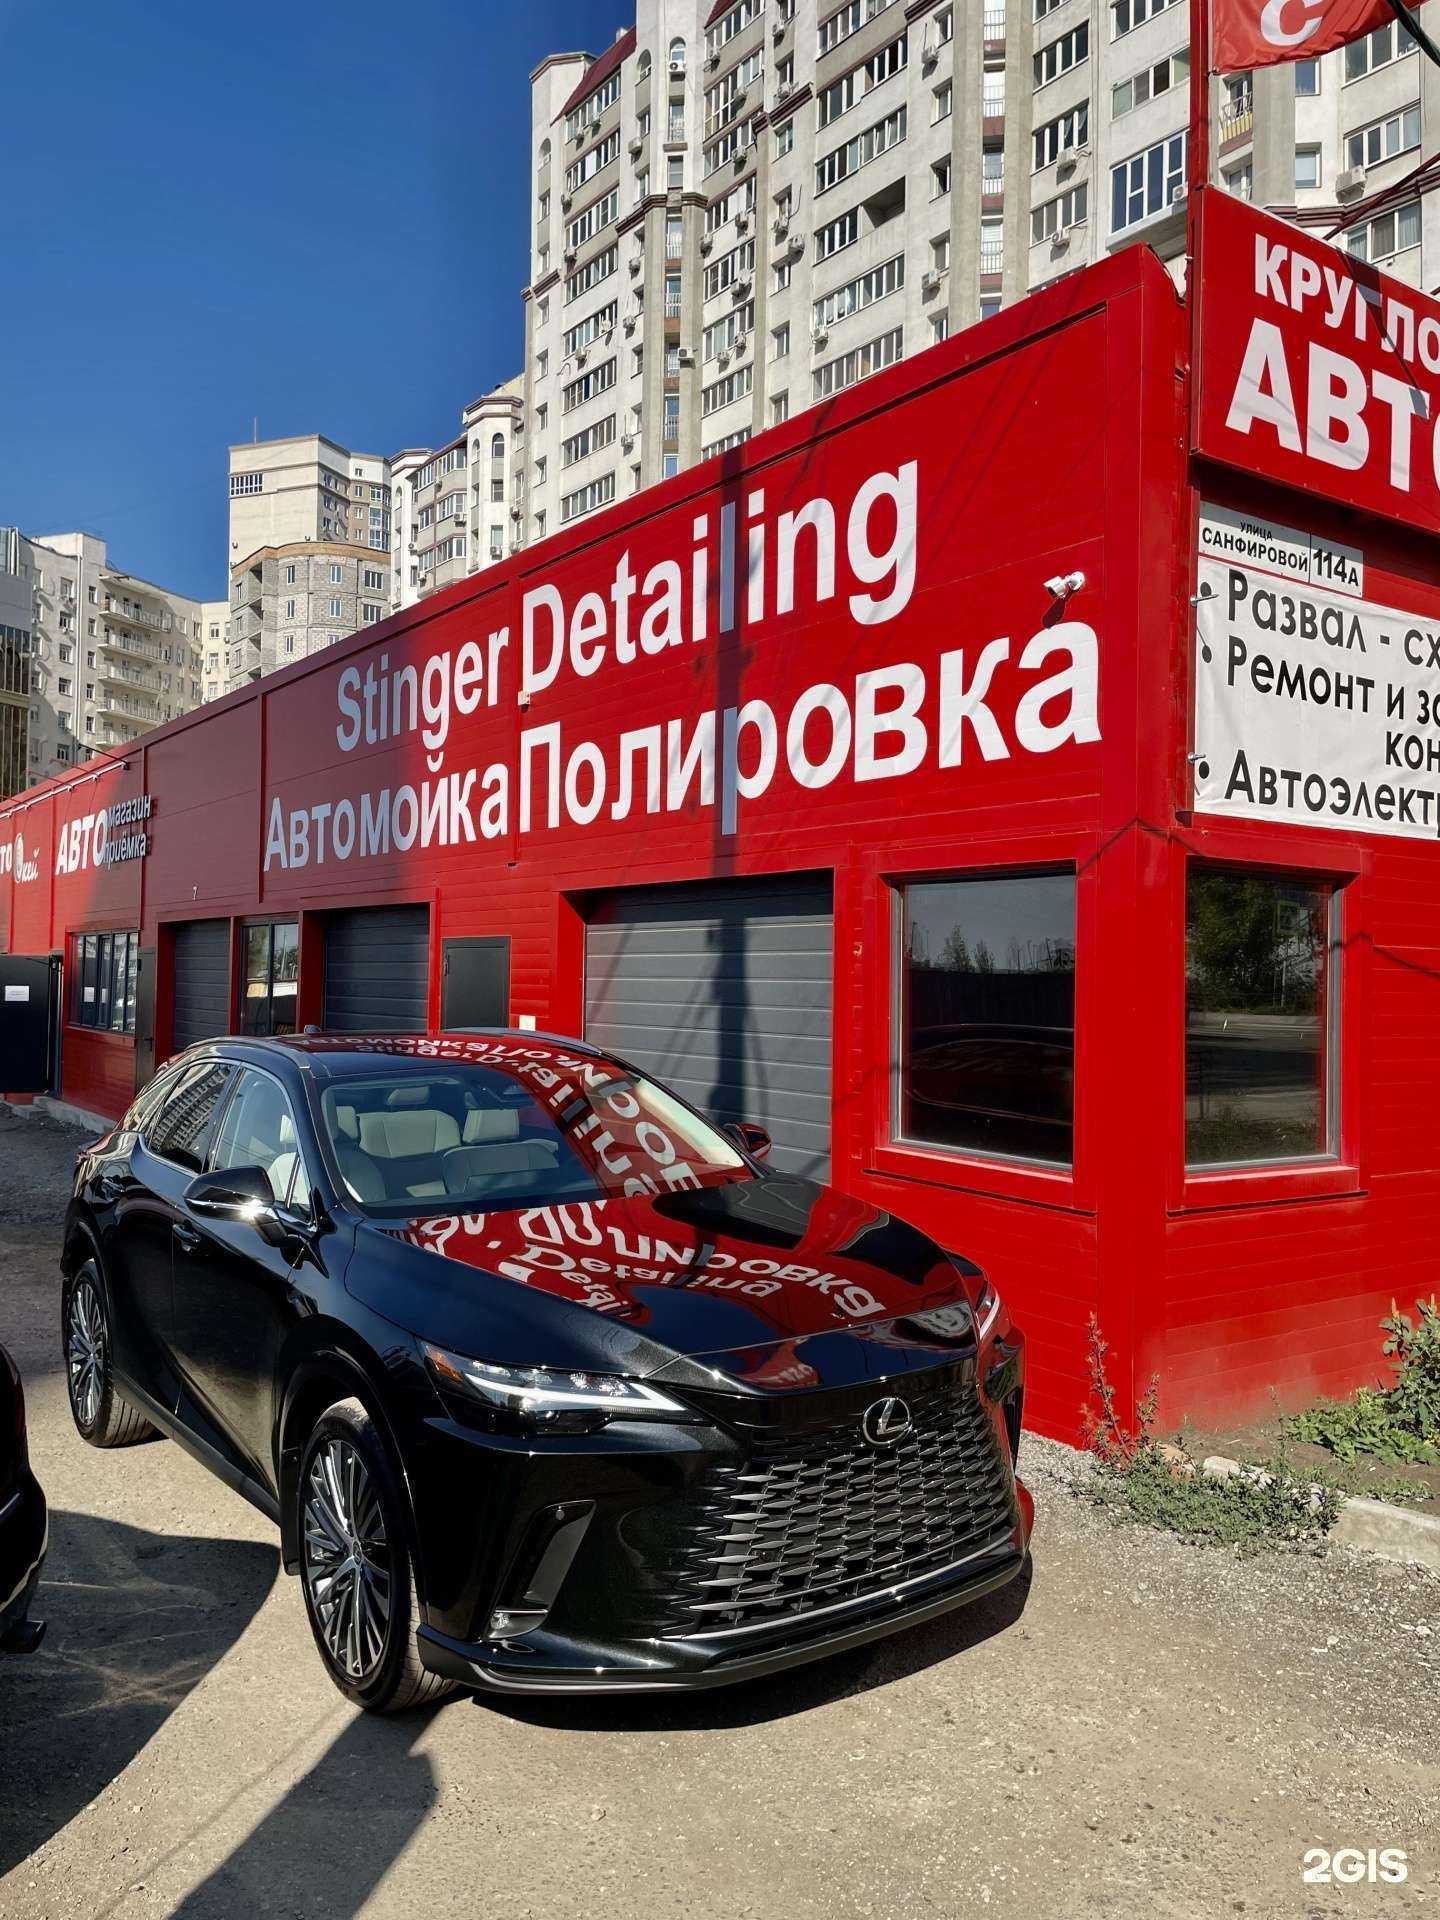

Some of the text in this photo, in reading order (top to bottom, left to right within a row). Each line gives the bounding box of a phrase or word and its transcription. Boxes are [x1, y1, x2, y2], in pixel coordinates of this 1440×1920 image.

[1254, 233, 1440, 375] КРУГЛО
[1225, 317, 1440, 493] АВТ
[1202, 527, 1309, 573] САНФИРОВОЙ
[1240, 521, 1273, 541] УЛИЦА
[336, 459, 918, 752] Stinger Detailing
[1228, 569, 1367, 653] Развал
[1227, 635, 1375, 714] Ремонт
[264, 621, 1103, 872] Автомойка Полировка
[55, 808, 108, 875] АВТО
